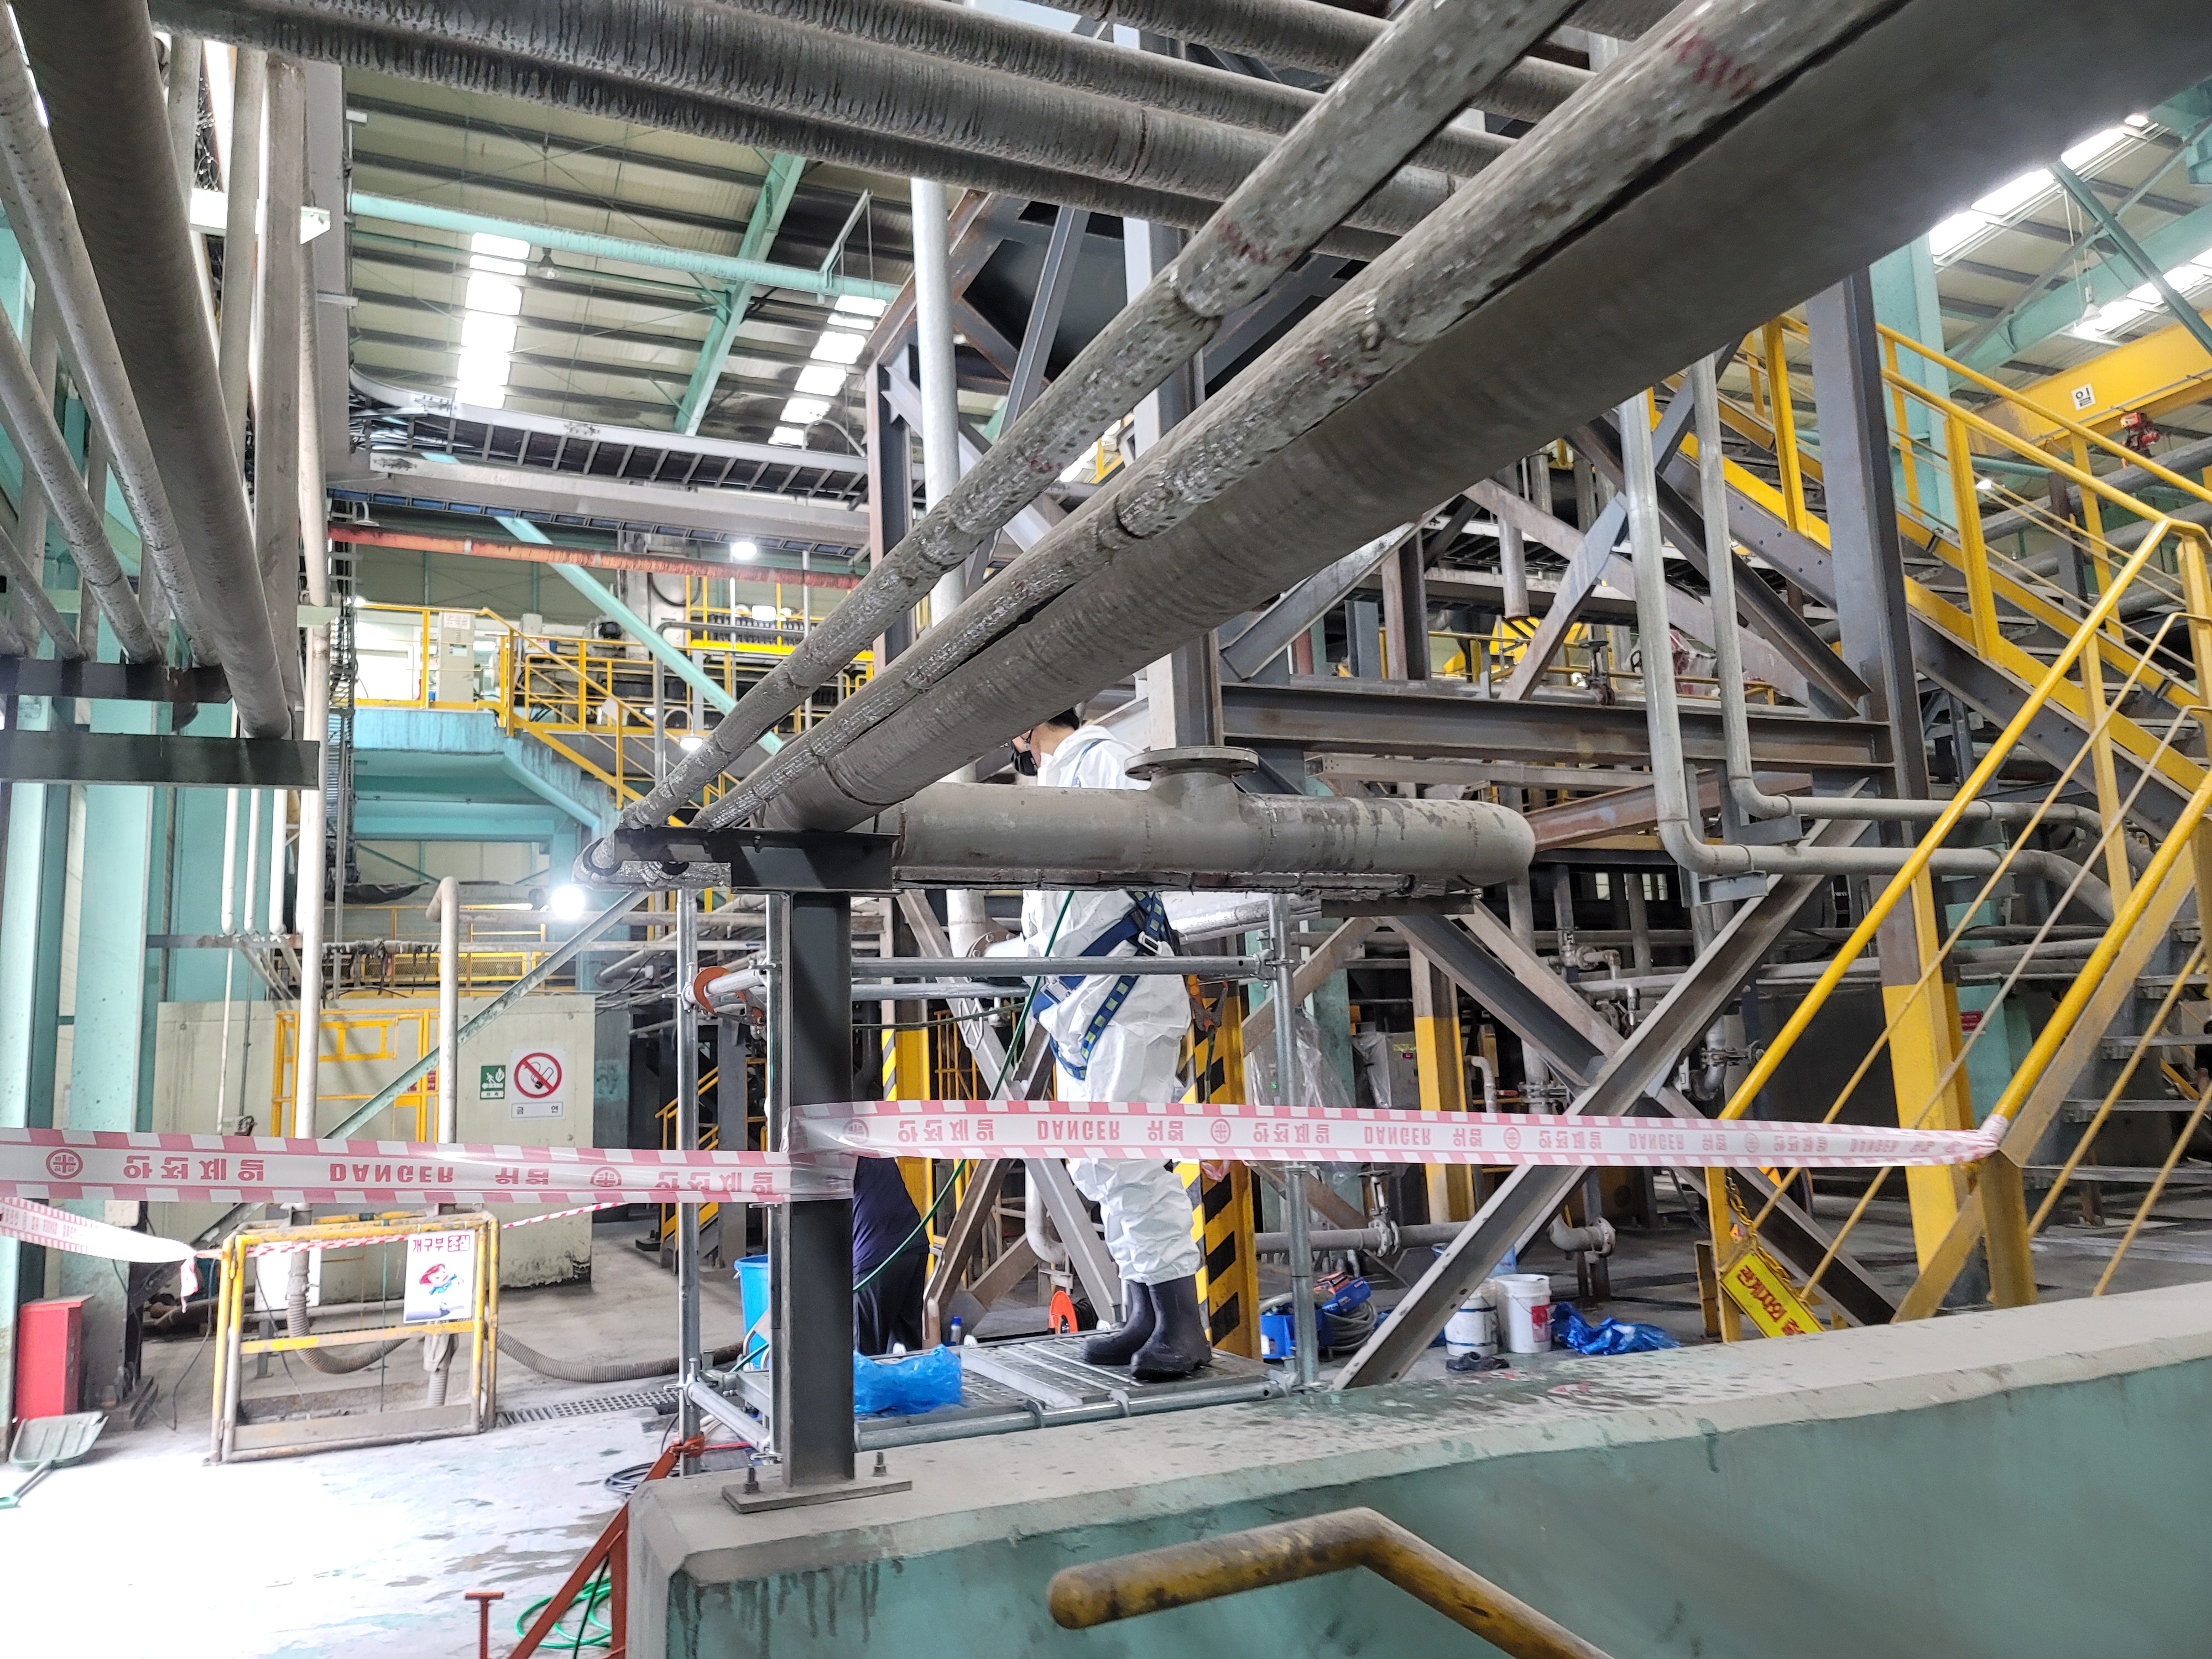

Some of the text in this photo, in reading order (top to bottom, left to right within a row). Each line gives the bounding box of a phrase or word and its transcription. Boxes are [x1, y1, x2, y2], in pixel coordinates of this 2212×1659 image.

[2075, 387, 2092, 406] 일
[413, 1235, 470, 1253] 개구부 조심
[1736, 1265, 1787, 1322] 관계자외
